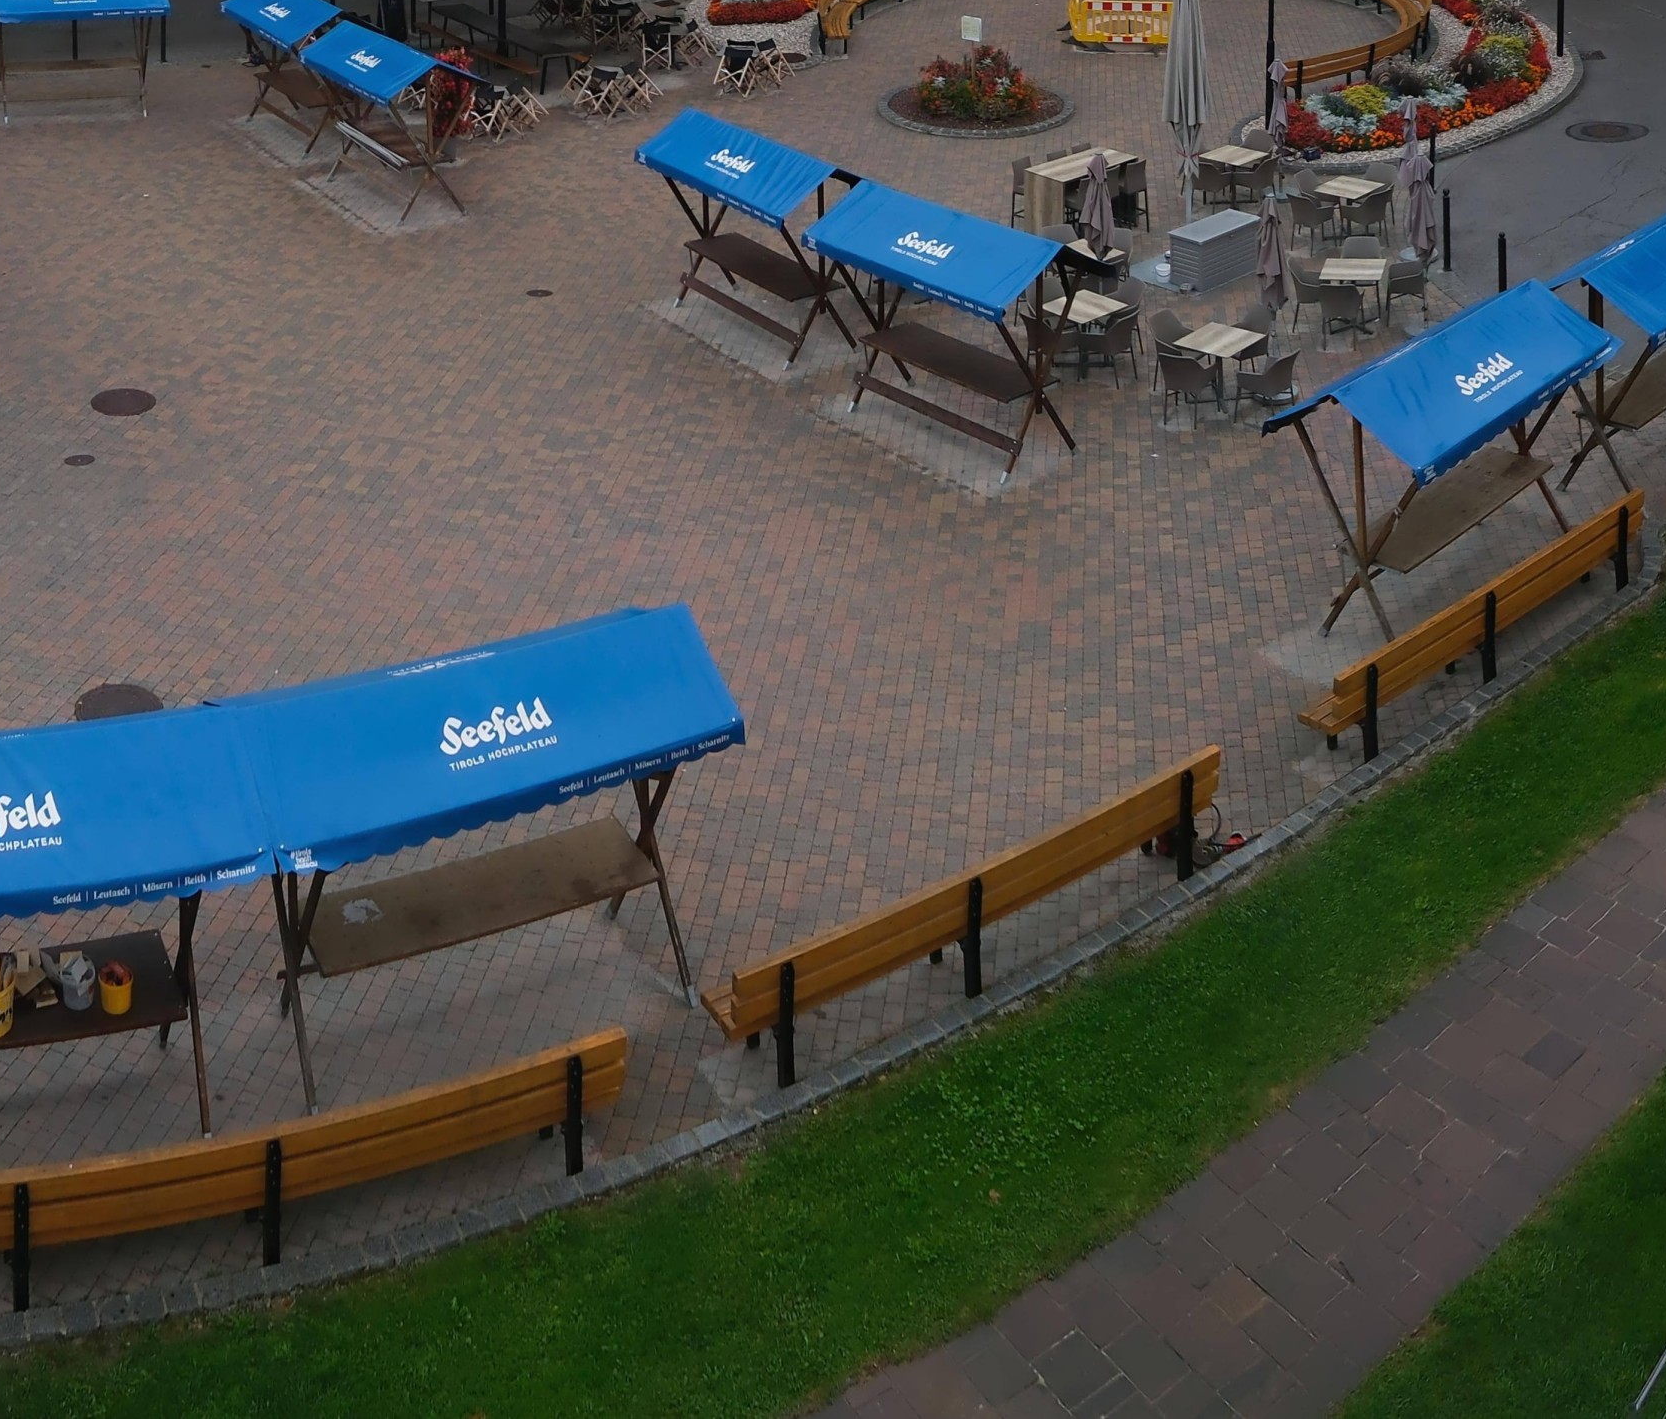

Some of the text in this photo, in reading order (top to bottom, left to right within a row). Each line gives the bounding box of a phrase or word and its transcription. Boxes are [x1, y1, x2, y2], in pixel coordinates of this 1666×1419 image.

[711, 148, 756, 174] Seefeld
[897, 231, 954, 259] Seefeld
[1455, 352, 1514, 397] Seefeld
[439, 696, 553, 756] Seefeld
[449, 735, 558, 772] TIROLS HOCHPLATEAU
[559, 734, 729, 794] Seefeld Leutasch Mösern Reith Scharnitz
[53, 865, 256, 906] Seefeld Leutasch Mösern Reith Scharnitz
